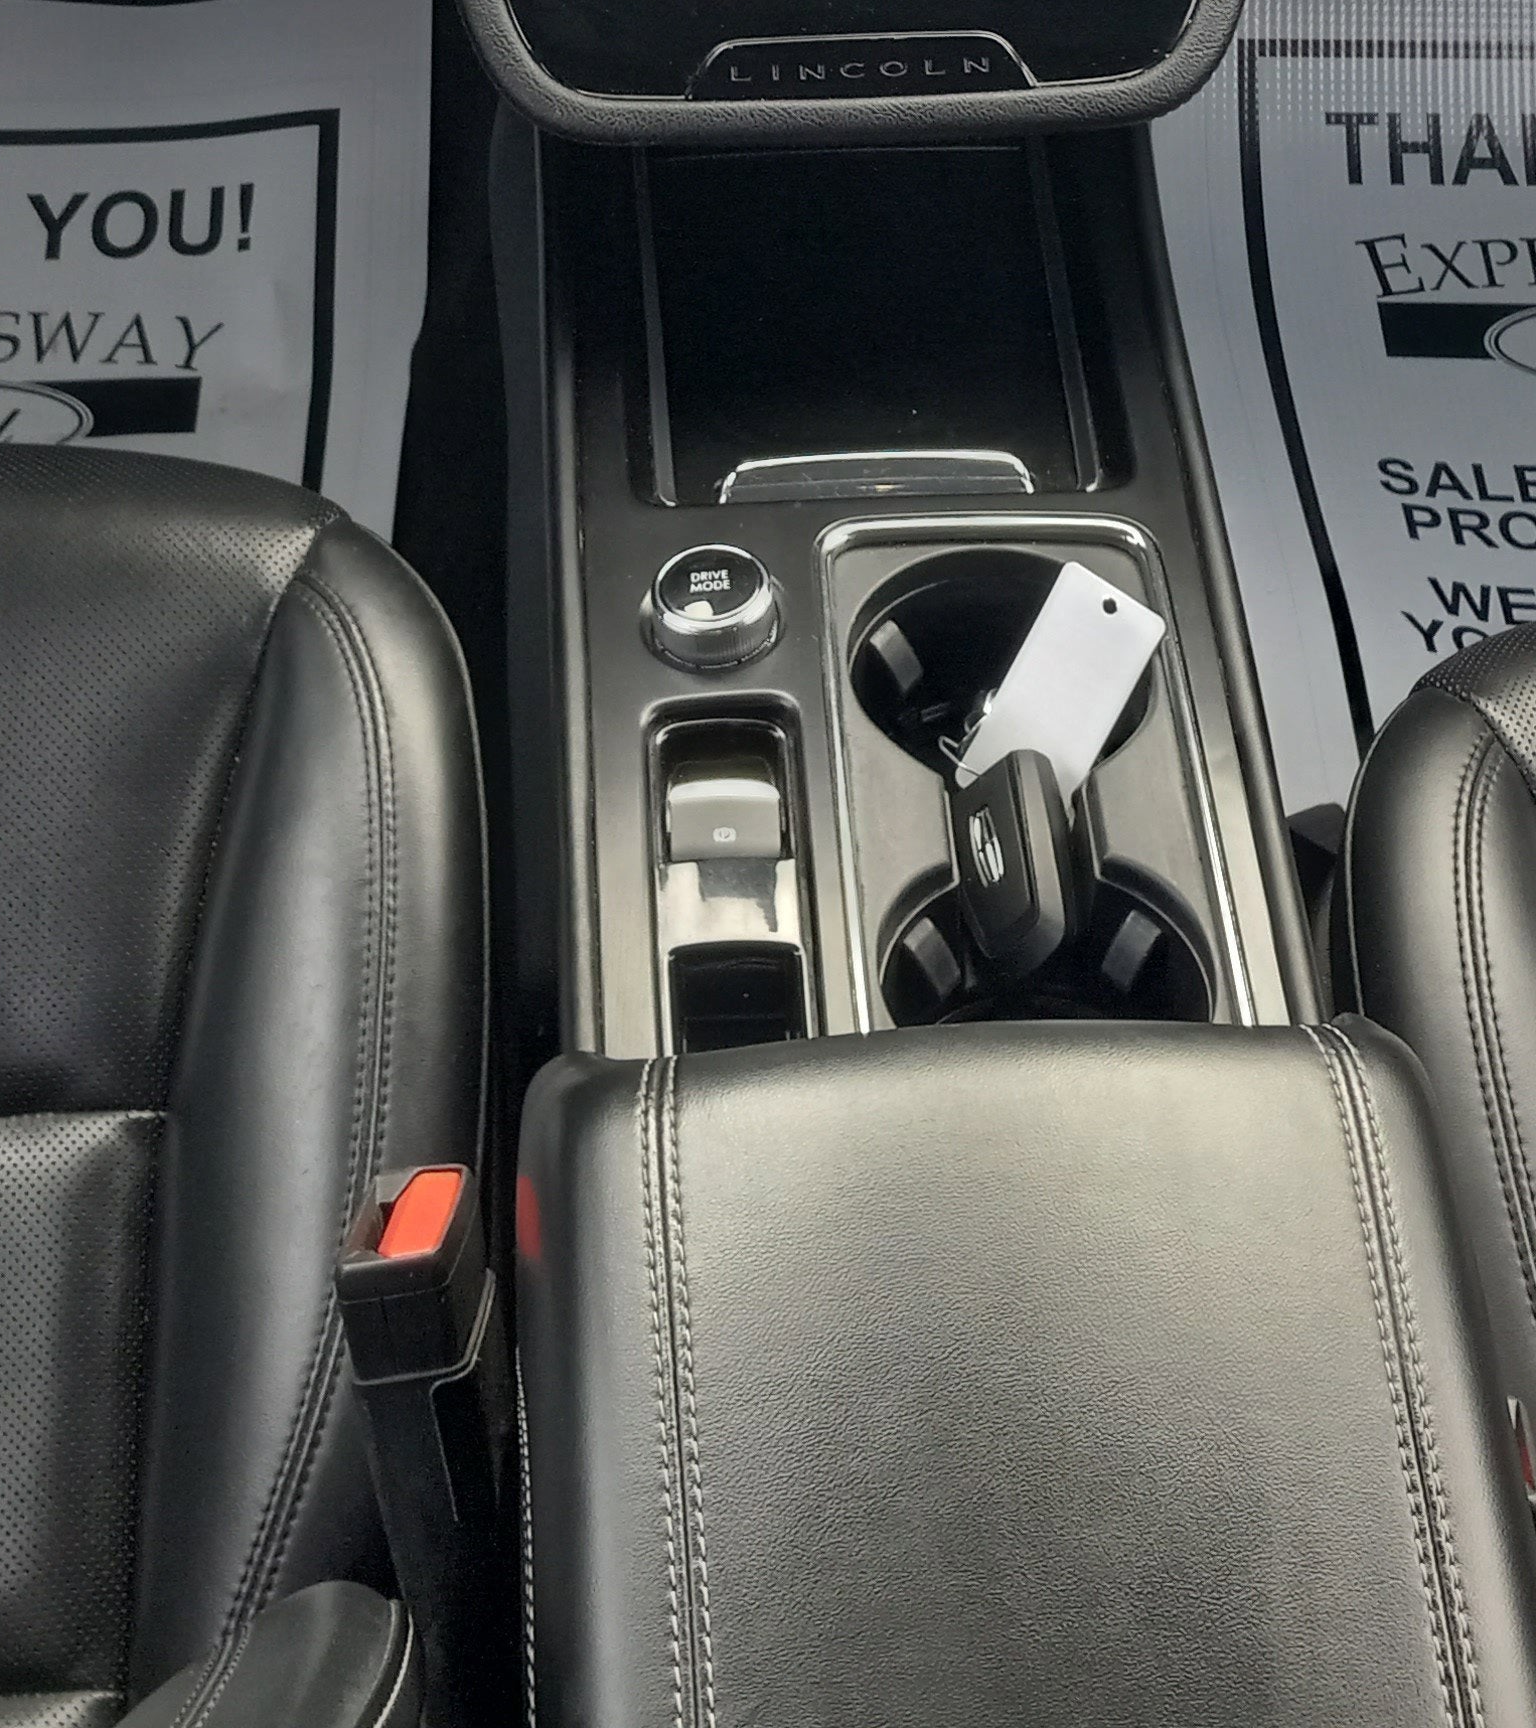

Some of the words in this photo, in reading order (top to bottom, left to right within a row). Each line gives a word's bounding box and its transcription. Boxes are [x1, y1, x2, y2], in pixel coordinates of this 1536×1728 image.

[730, 57, 990, 81] LINCOLN
[27, 182, 257, 260] YOU!
[690, 569, 729, 583] DRIVE
[689, 579, 731, 594] MODE
